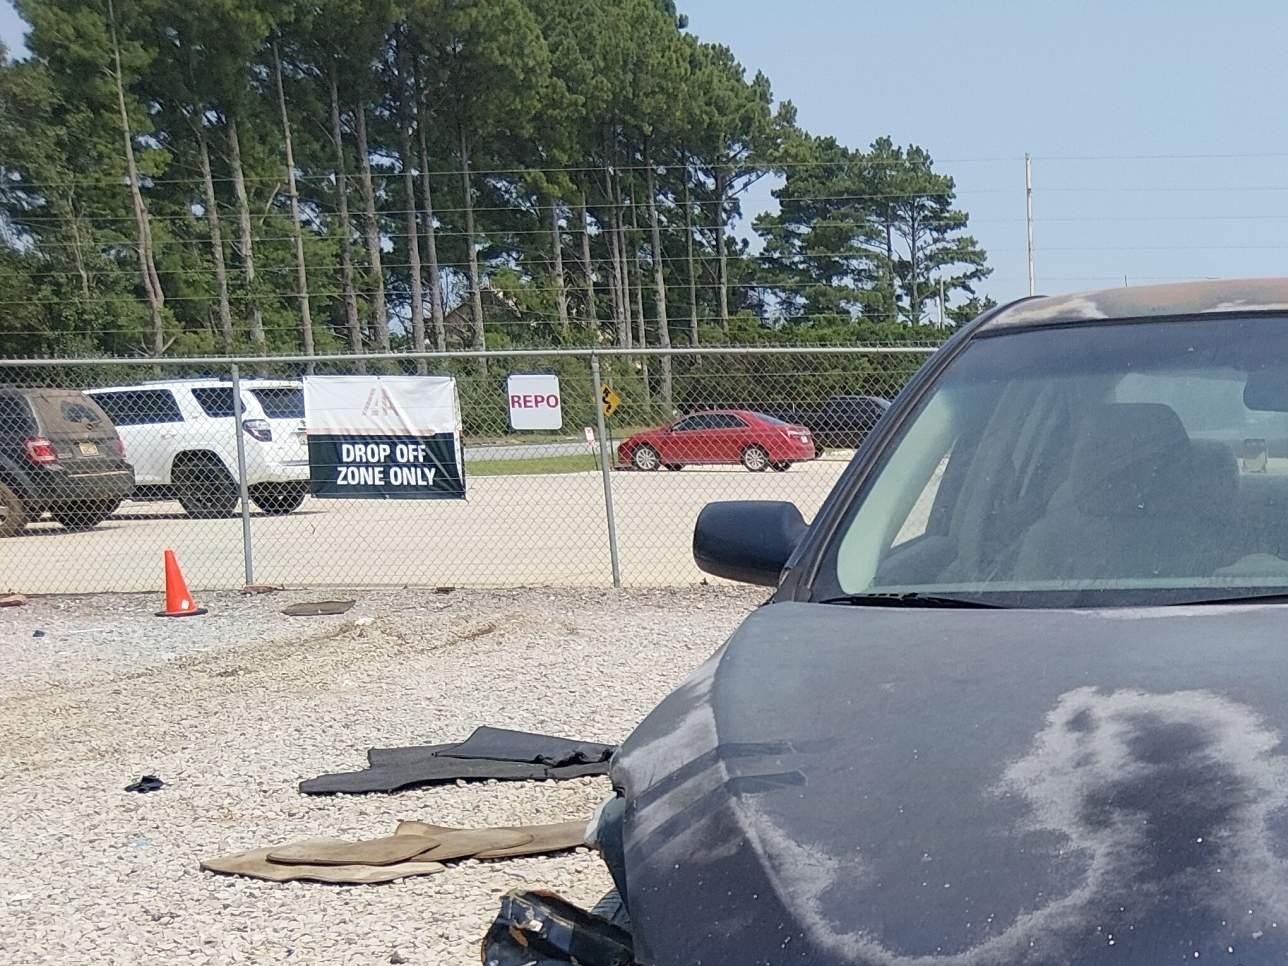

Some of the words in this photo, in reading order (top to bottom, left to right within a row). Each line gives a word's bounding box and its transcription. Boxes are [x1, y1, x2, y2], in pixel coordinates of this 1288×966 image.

[510, 394, 559, 409] REPO
[342, 444, 390, 463] DROP
[396, 444, 426, 462] OFF
[336, 467, 385, 486] ZONE
[390, 466, 436, 486] ONLY
